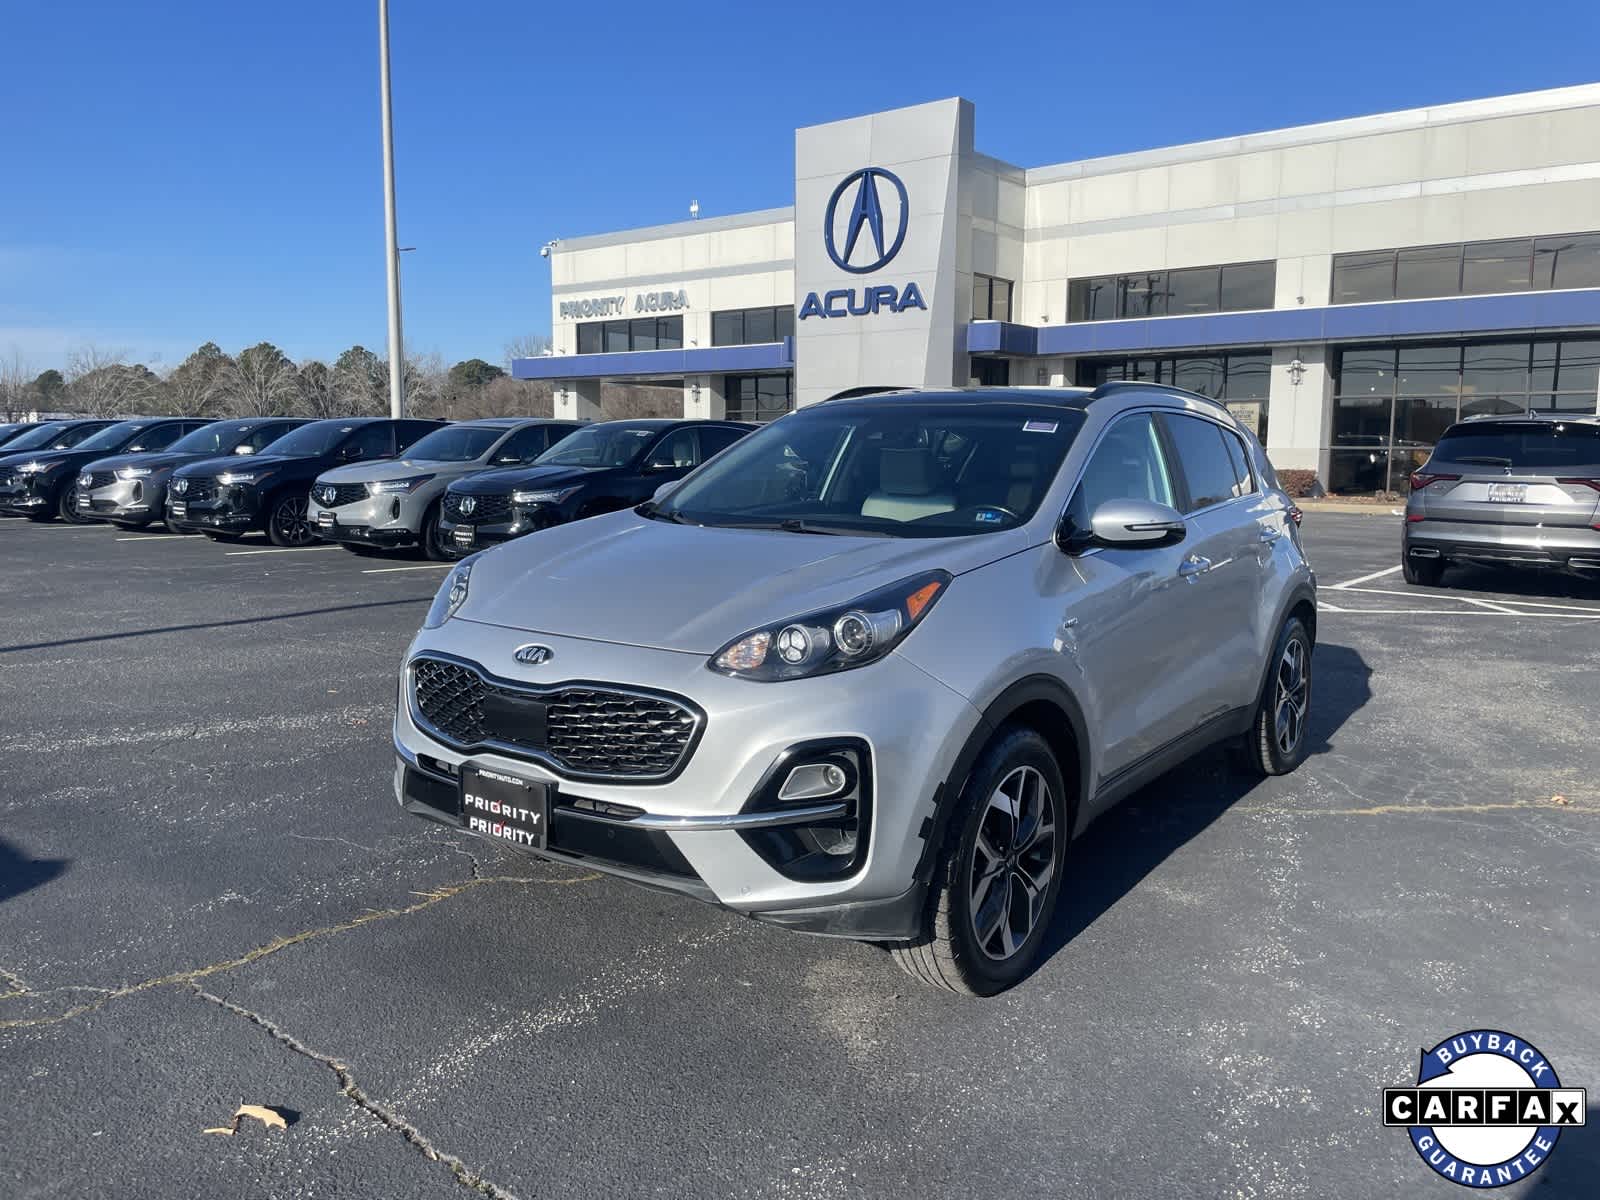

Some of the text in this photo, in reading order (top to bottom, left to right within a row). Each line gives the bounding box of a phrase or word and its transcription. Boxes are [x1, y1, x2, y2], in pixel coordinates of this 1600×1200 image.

[559, 289, 690, 319] PRIORITY ACURA
[798, 282, 927, 320] ACURA
[516, 647, 546, 662] KIA
[464, 793, 541, 824] PRIORITY
[469, 816, 535, 845] PRIORITY
